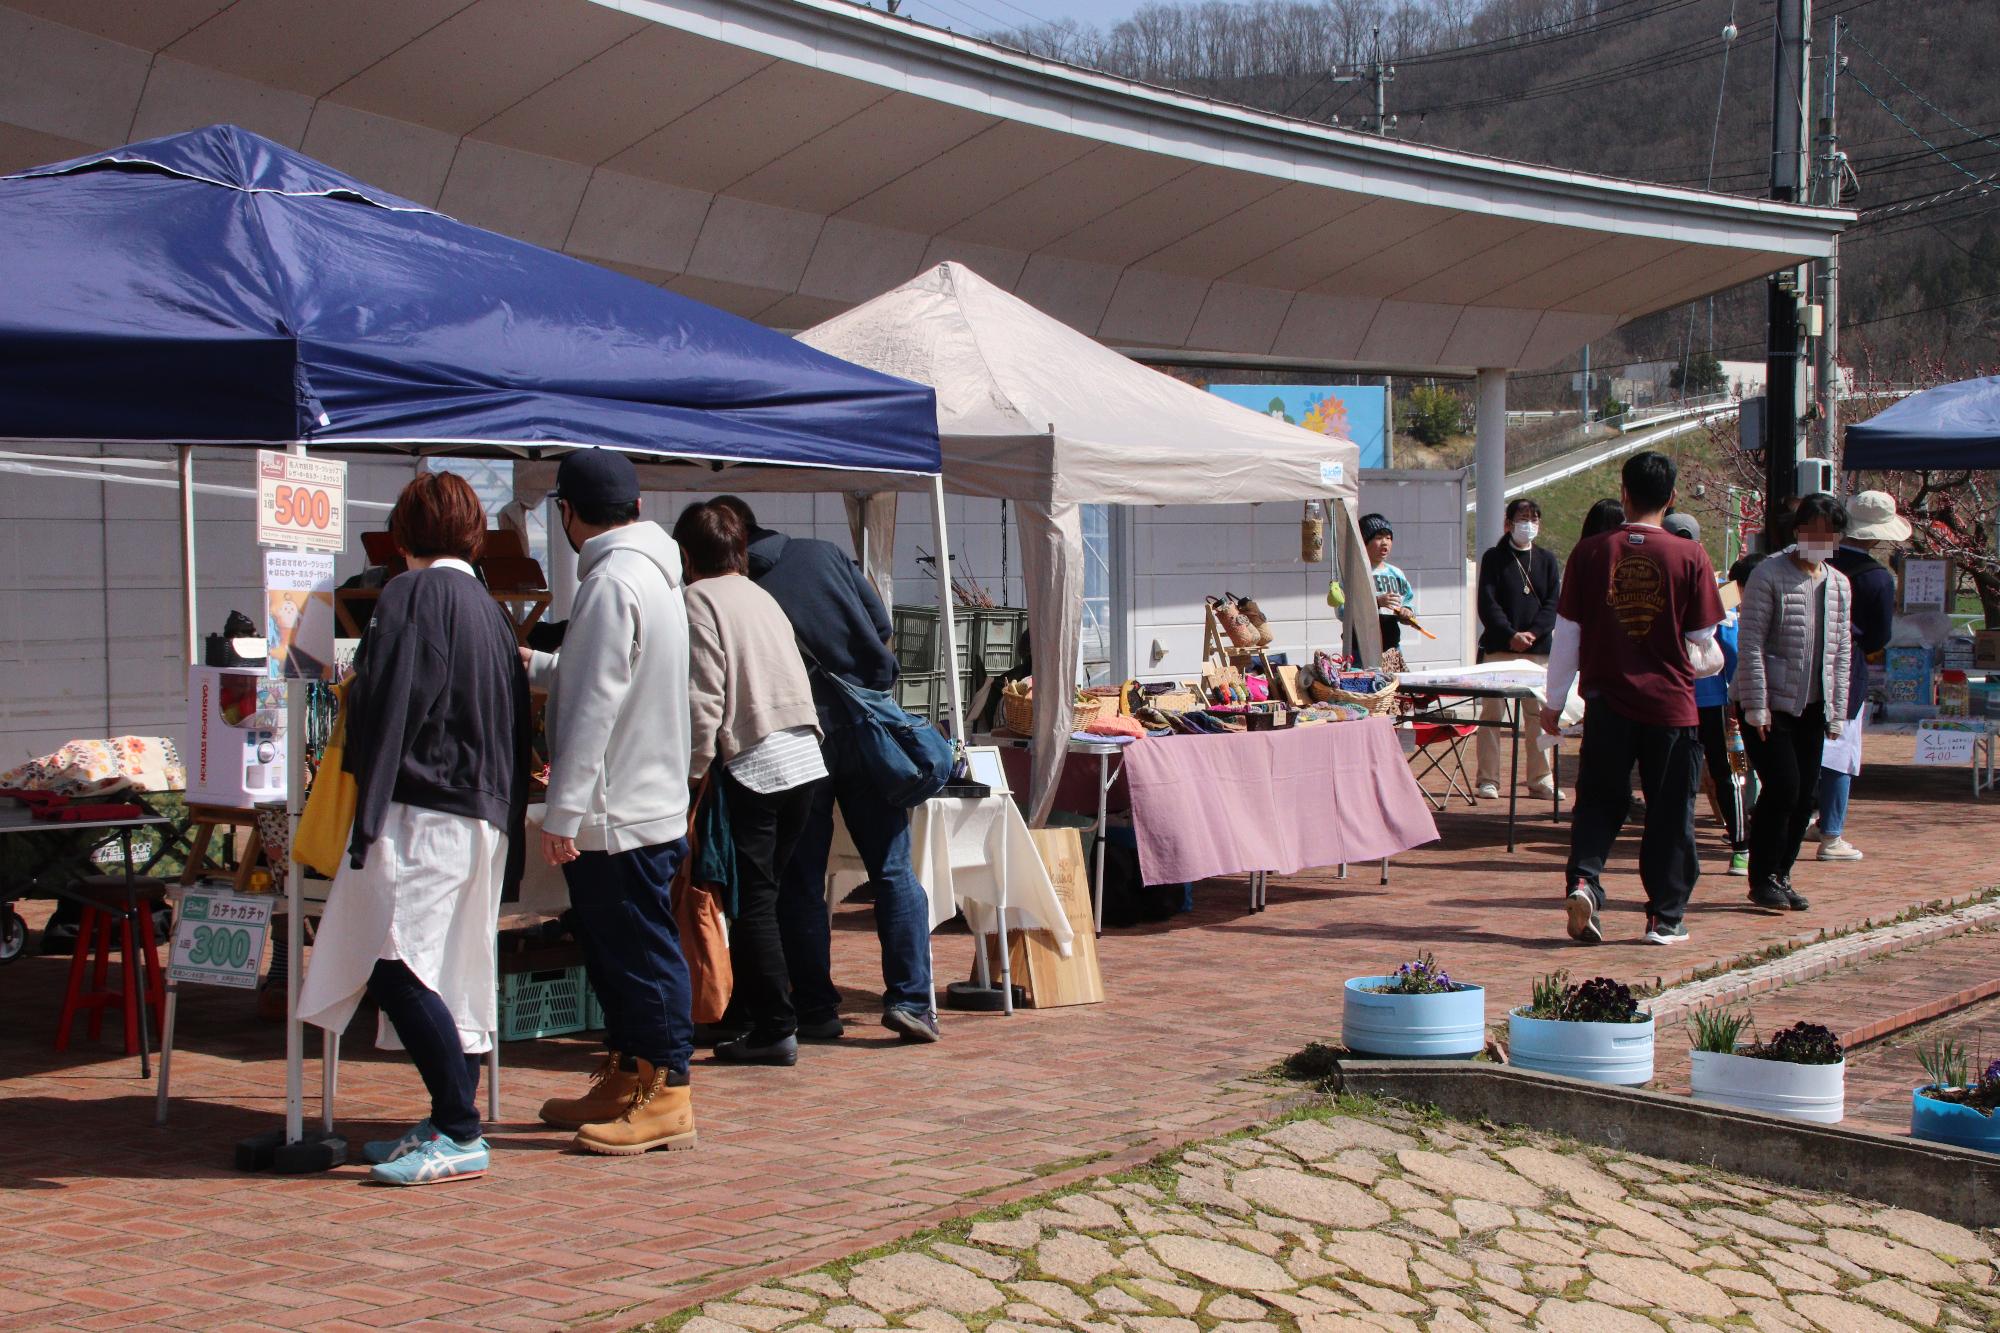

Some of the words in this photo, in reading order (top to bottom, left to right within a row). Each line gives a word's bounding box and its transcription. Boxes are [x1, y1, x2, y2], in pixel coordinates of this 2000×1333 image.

[274, 484, 331, 530] 500
[331, 507, 339, 520] 円
[211, 903, 265, 920] ガチャガチャ
[188, 925, 251, 969] 300
[246, 959, 256, 969] 円
